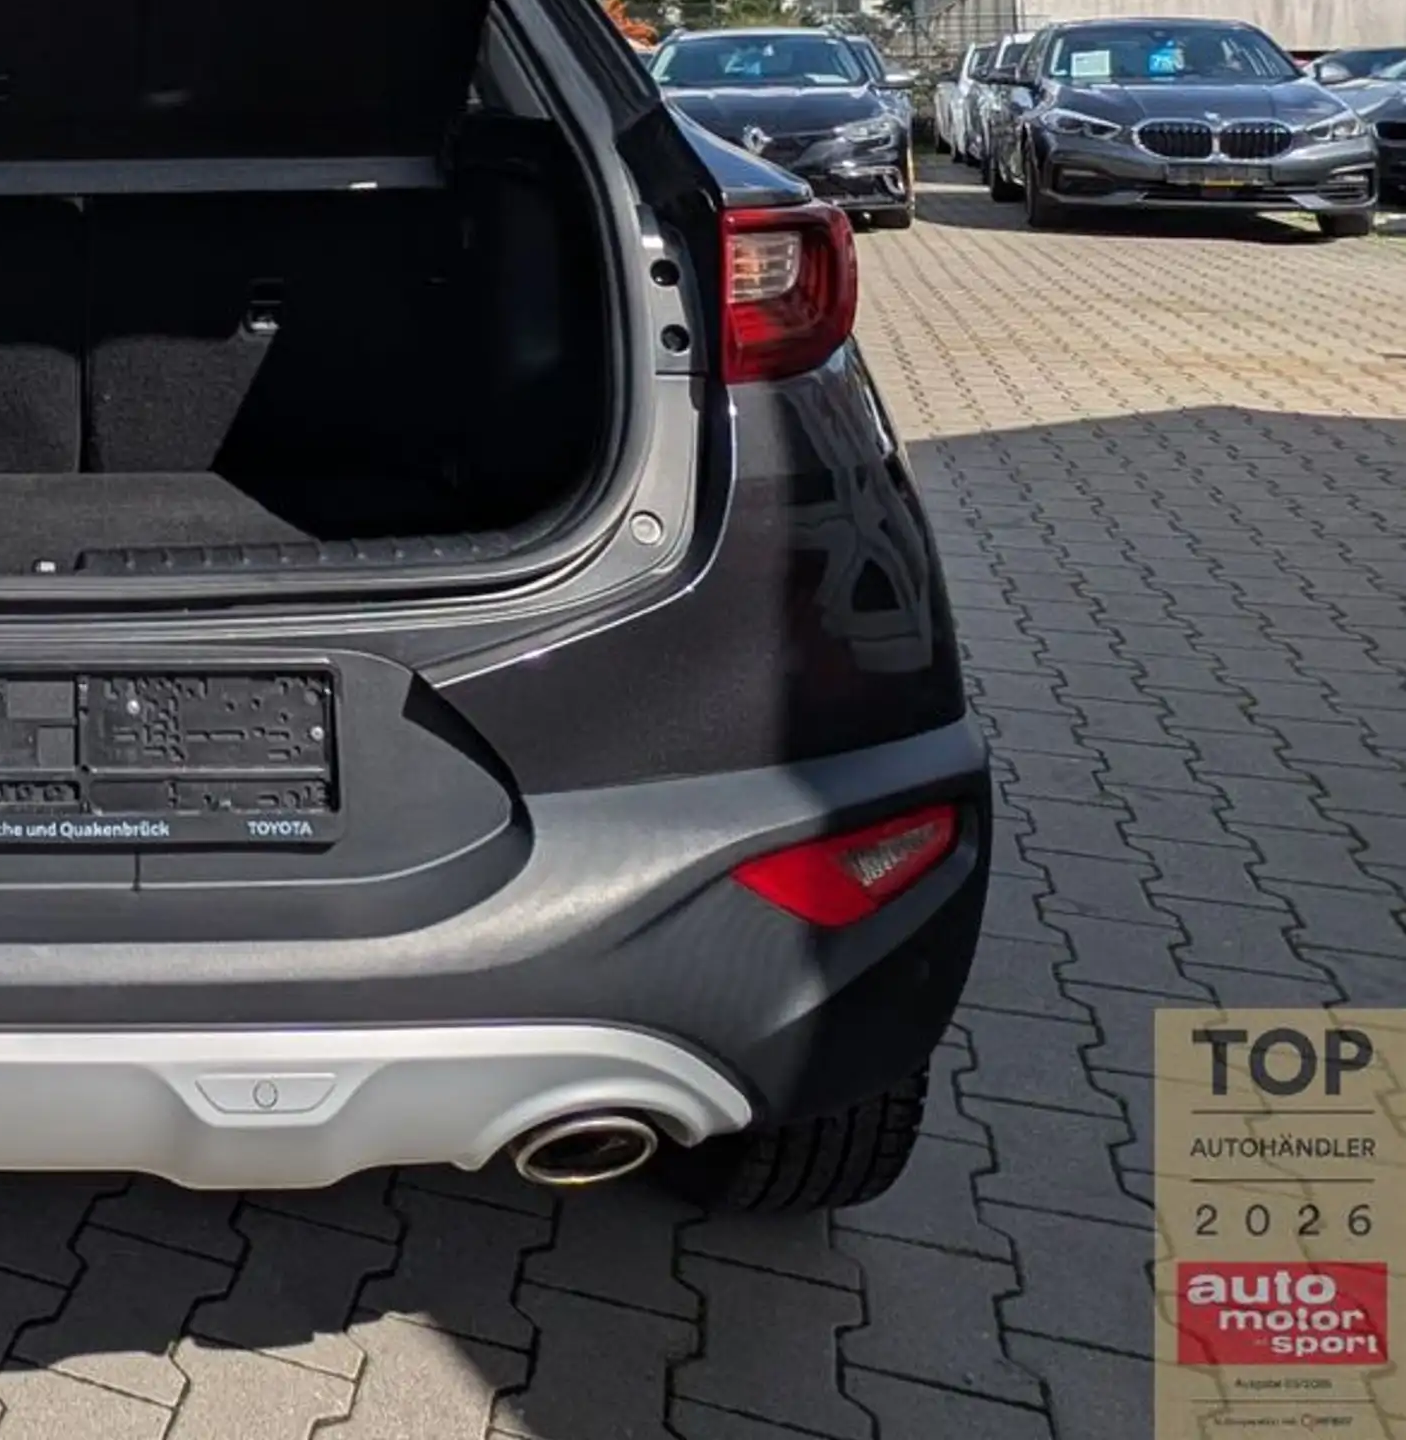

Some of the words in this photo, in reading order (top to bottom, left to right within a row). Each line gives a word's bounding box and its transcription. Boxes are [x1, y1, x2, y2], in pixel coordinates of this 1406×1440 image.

[26, 821, 57, 837] und
[59, 820, 170, 840] Quakenbrück
[247, 820, 313, 836] TOYOTA
